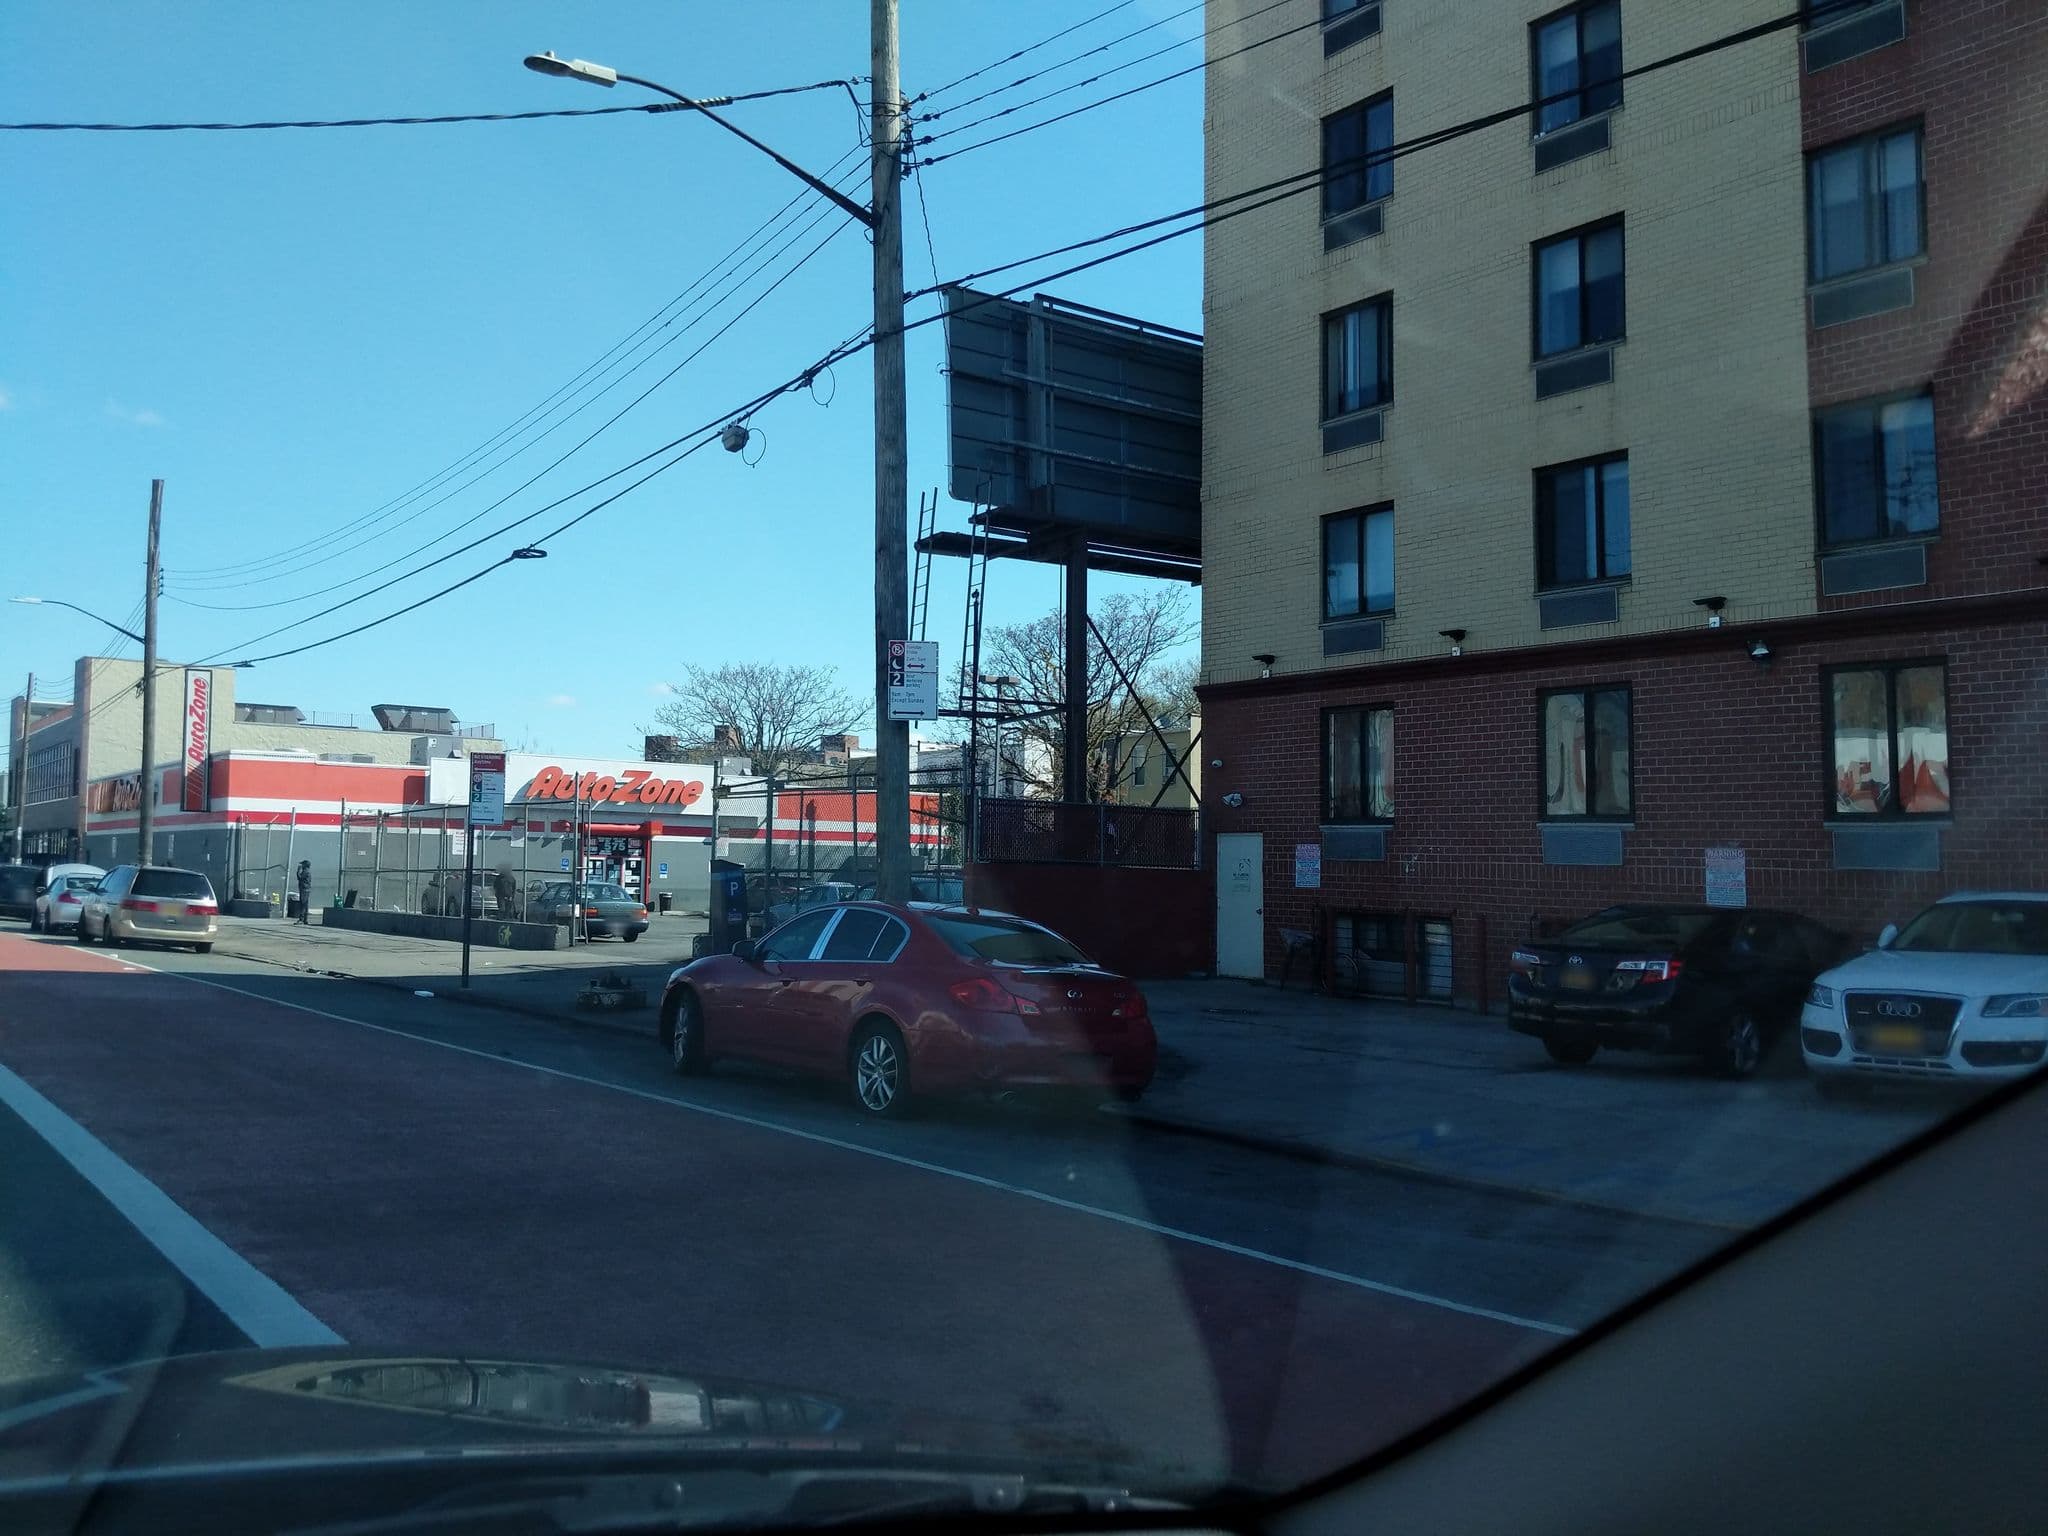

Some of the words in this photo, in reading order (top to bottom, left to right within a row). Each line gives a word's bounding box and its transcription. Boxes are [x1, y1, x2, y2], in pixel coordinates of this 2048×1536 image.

[893, 673, 901, 685] 2
[188, 677, 209, 763] AutoZone
[526, 766, 704, 806] AutoZone
[474, 794, 480, 802] 2
[1706, 849, 1744, 857] WARNING
[730, 881, 739, 896] P
